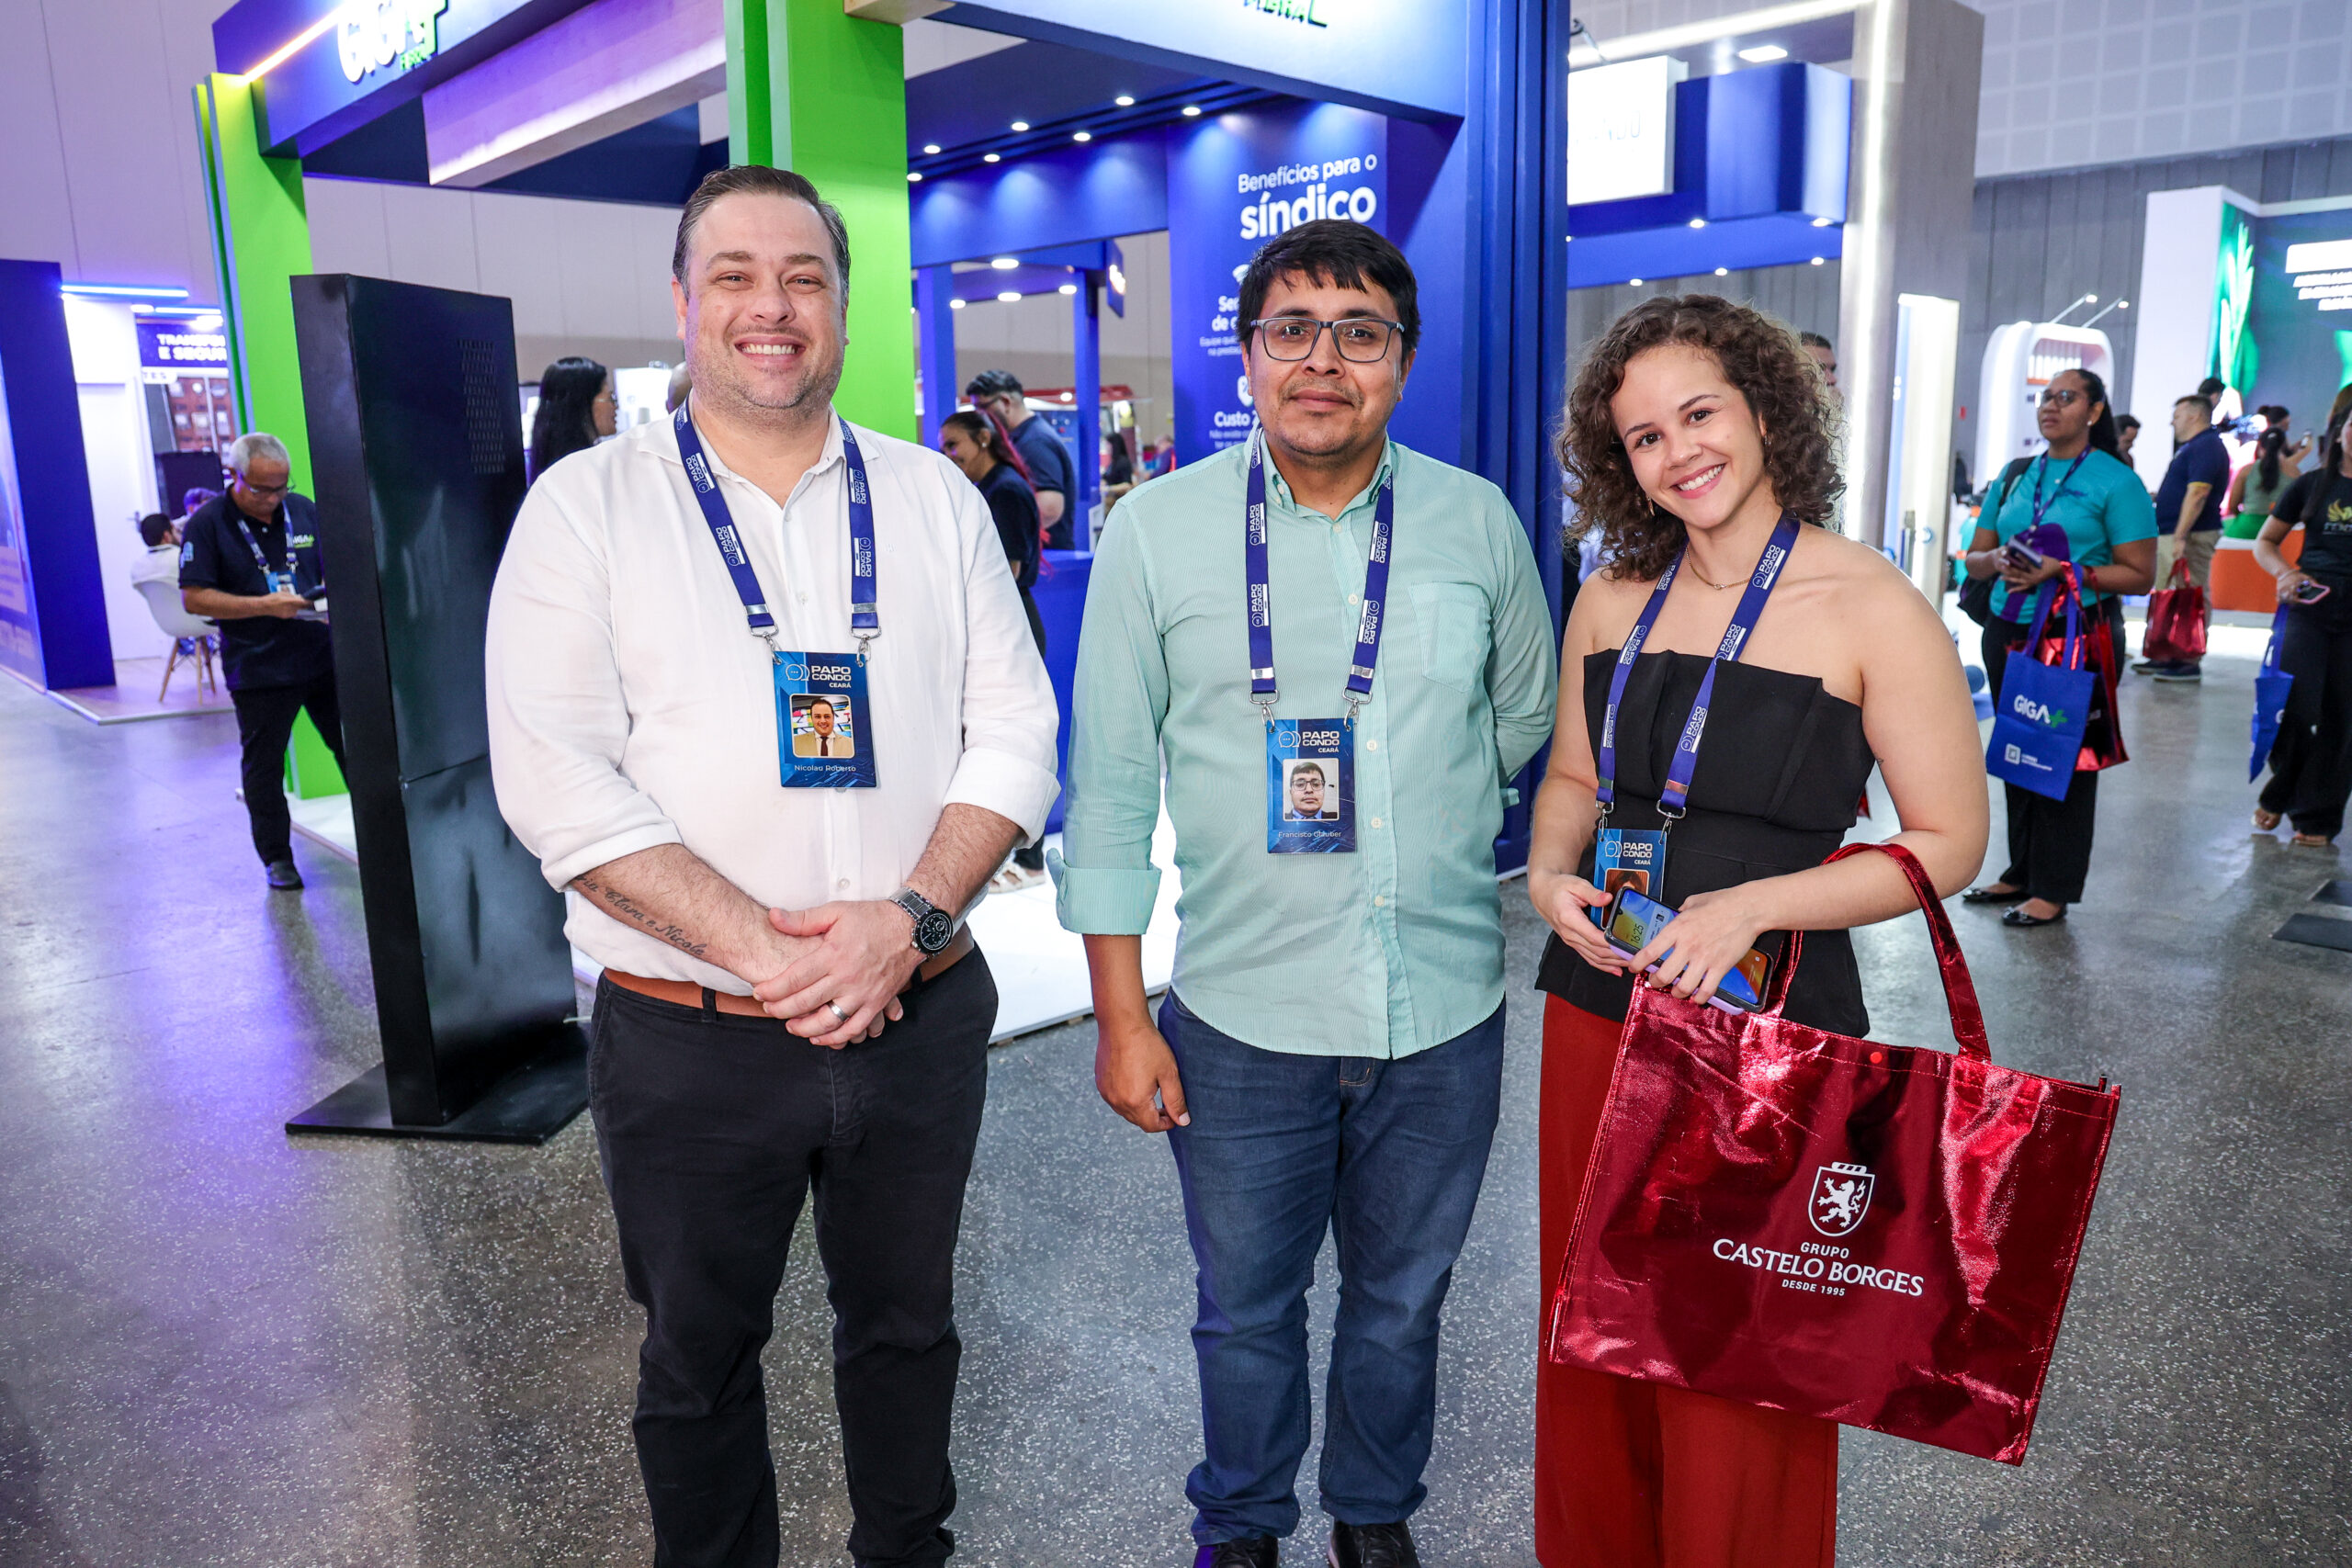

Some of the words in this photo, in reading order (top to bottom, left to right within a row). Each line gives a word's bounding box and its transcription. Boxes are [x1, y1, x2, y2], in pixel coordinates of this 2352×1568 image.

[1238, 164, 1319, 194] Benefícios
[1322, 157, 1361, 182] para
[1364, 153, 1377, 171] o
[1240, 183, 1377, 240] síndico
[1214, 411, 1250, 428] Custo
[685, 457, 700, 481] PAPO
[691, 455, 705, 479] CONDO
[716, 527, 730, 553] PAPO
[721, 525, 736, 551] CONDO
[1379, 537, 1387, 563] PAPO
[1758, 544, 1776, 572] PAPO
[1764, 547, 1781, 574] CONDO
[1363, 615, 1372, 643] CONDO
[1368, 615, 1377, 644] PAPO
[1720, 624, 1736, 652] PAPO
[1725, 626, 1741, 653] CONDO
[1626, 638, 1641, 665] PAPO
[811, 665, 851, 674] PAPO
[812, 673, 852, 682] CONDO
[1686, 705, 1702, 735] PAPO
[1691, 707, 1706, 736] CONDO
[1302, 730, 1340, 739] PAPO
[1302, 739, 1340, 747] CONDO
[825, 764, 856, 773] Roberto
[1623, 842, 1653, 852] PAPO
[655, 925, 707, 955] Nicole
[1800, 1241, 1850, 1259] GRUPO
[1713, 1238, 1825, 1278] CASTELO
[1827, 1261, 1925, 1297] BORGES
[1781, 1279, 1817, 1292] DESDE
[1820, 1285, 1846, 1297] 1995
